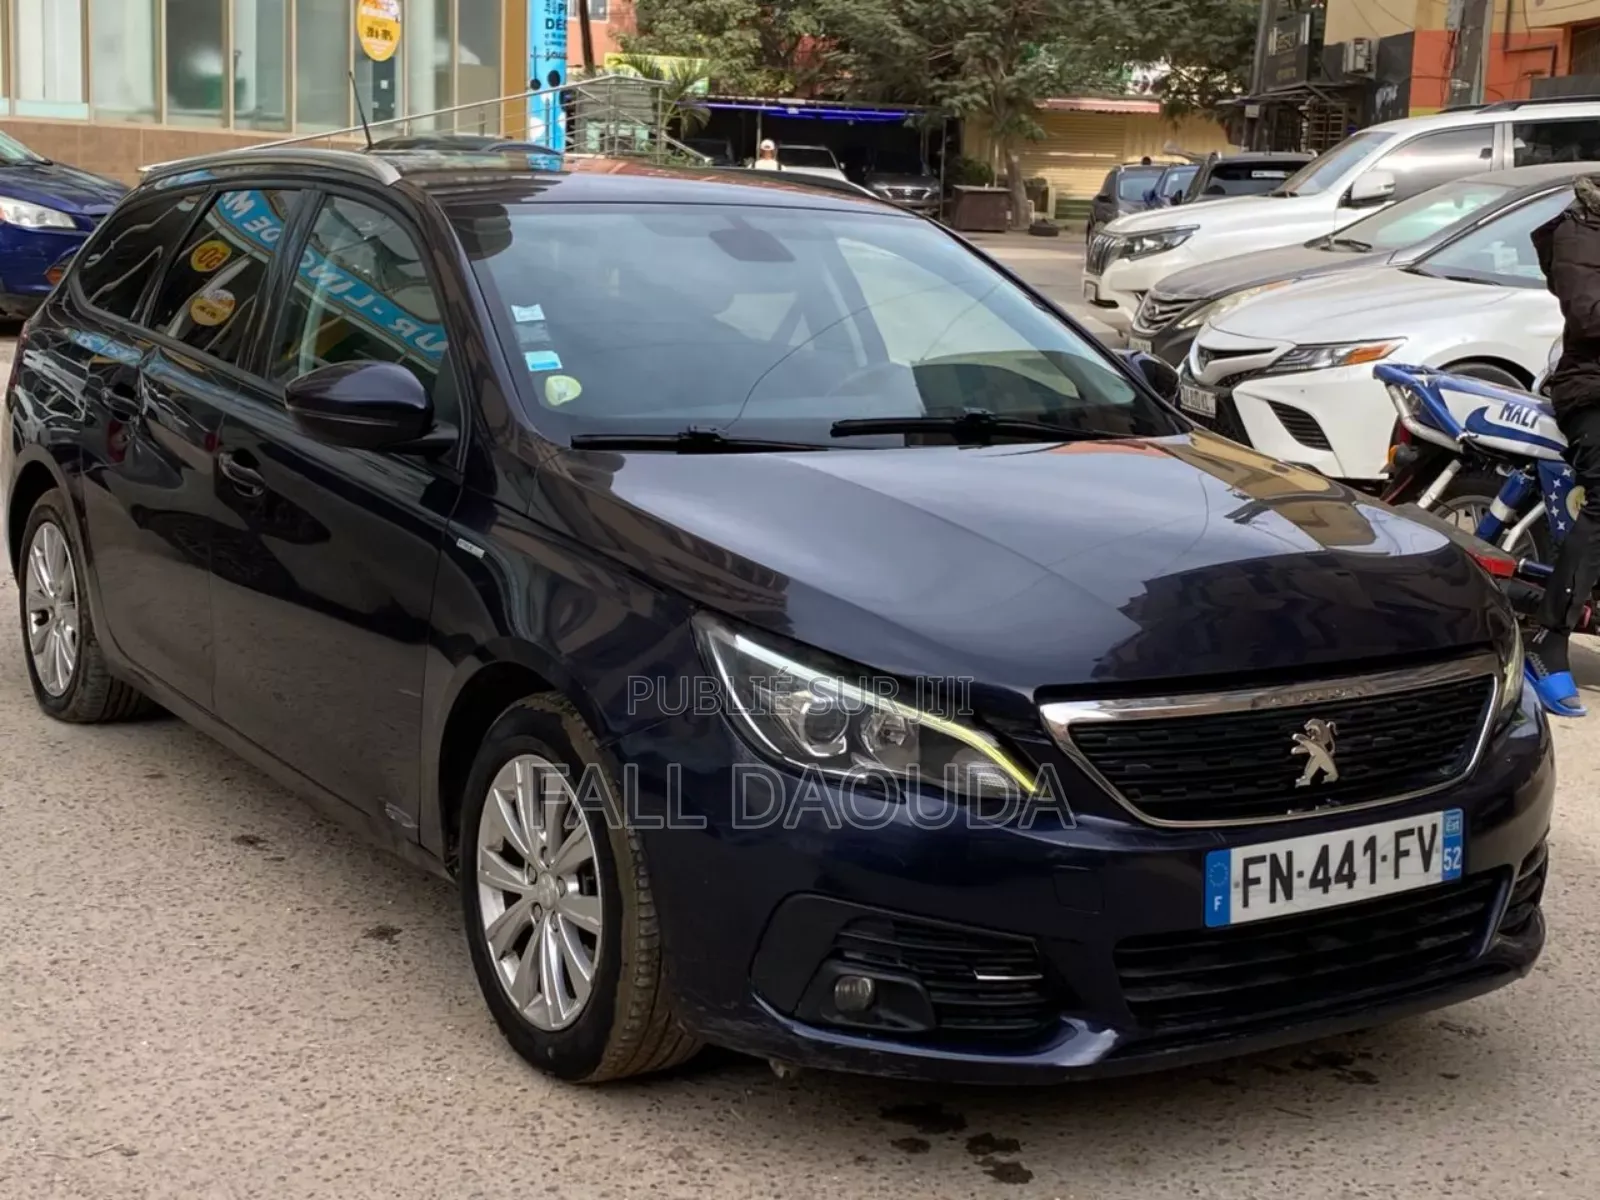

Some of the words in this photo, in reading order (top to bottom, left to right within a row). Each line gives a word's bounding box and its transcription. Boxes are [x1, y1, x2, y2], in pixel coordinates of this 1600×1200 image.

[1498, 402, 1539, 429] MALI
[1443, 846, 1462, 871] 52
[1213, 895, 1223, 912] F
